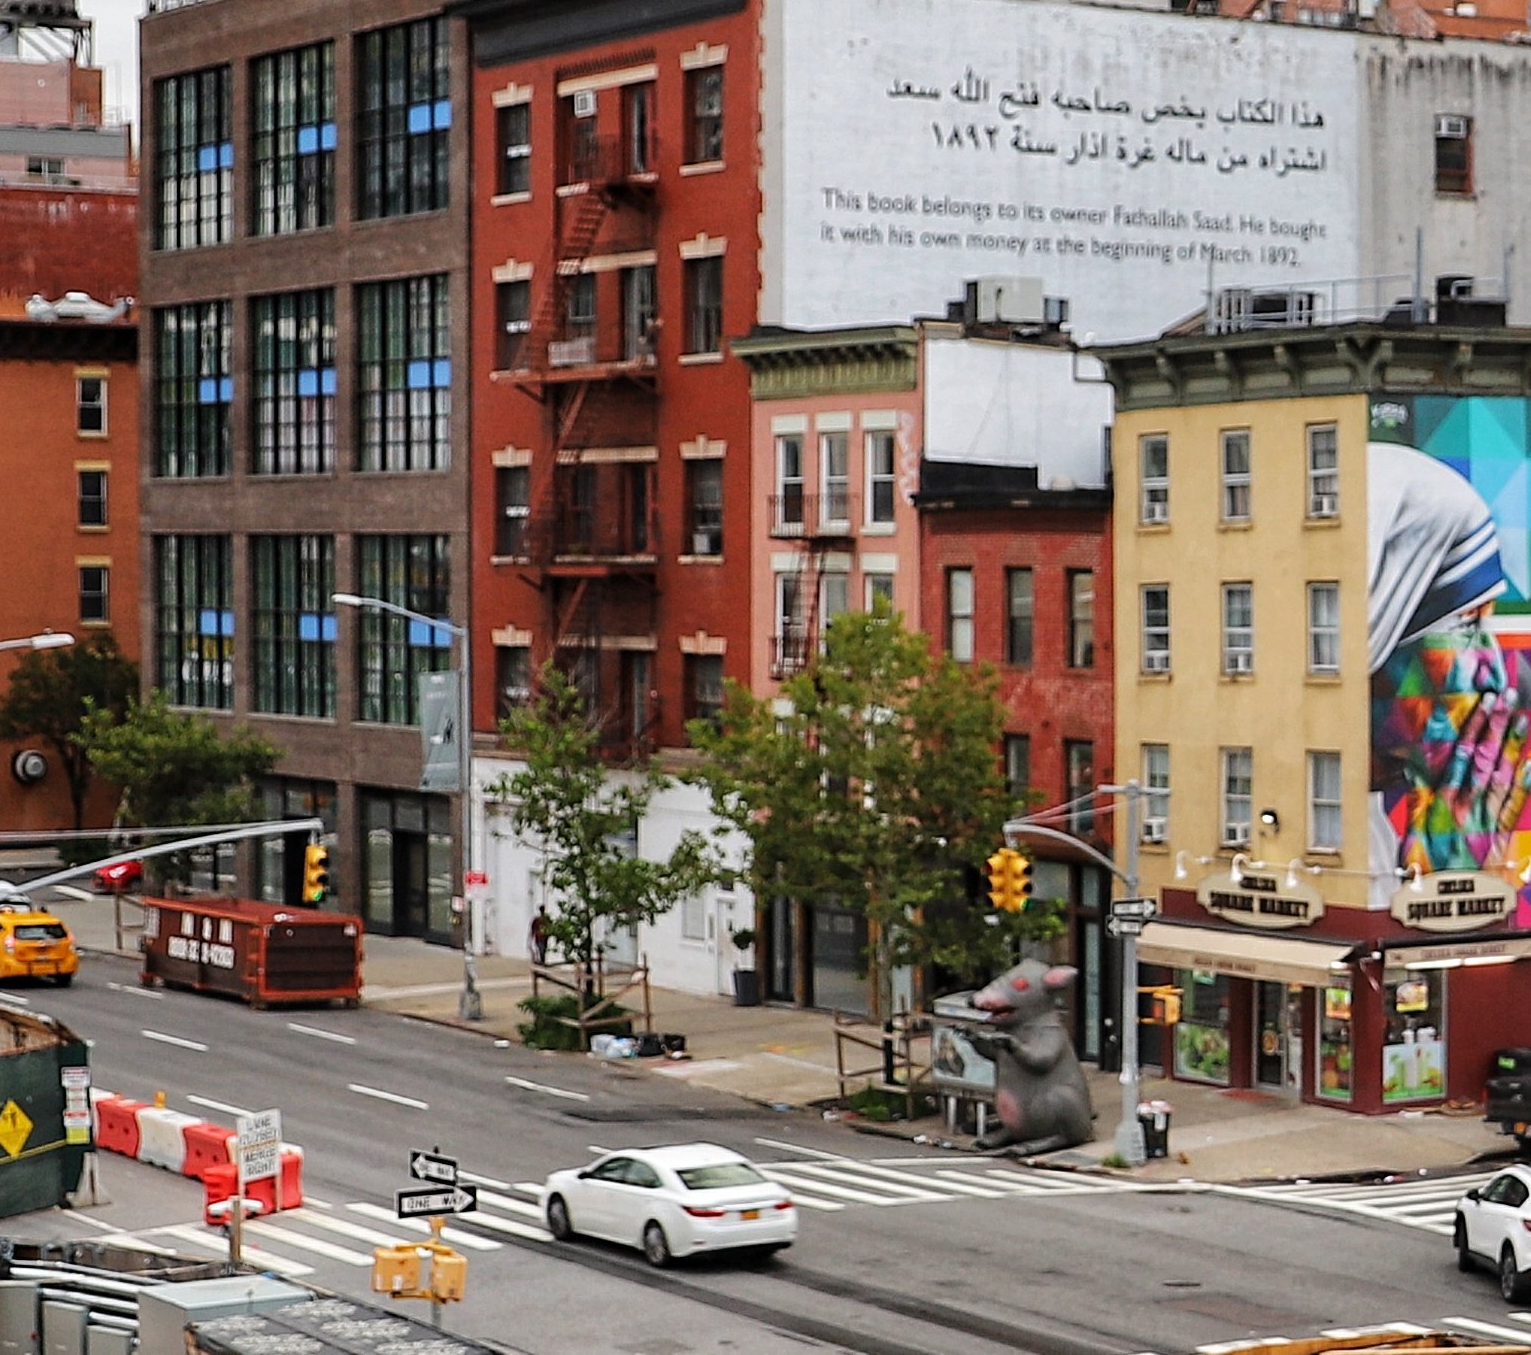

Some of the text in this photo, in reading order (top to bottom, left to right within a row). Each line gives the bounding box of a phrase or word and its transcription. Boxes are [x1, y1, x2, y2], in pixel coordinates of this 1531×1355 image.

[886, 64, 1325, 134] هذا الكتاب يخص صاحبه فتح الله سعد
[931, 121, 999, 151] ١٨٩٢
[1010, 124, 1058, 154] سنة
[1167, 136, 1207, 164] ماله
[1116, 136, 1155, 169] غرة
[1217, 146, 1248, 173] من
[1259, 145, 1326, 177] اشتراه
[822, 187, 1326, 241] This book belongs to its owner Fathallah Saad. He bought
[820, 222, 1301, 267] it with his own money at the beginning of March 1892.
[1437, 878, 1475, 894] CHELSEA
[1210, 891, 1309, 920] SQUARE MARKET
[1407, 895, 1505, 921] SQUARE MARKET
[406, 1195, 431, 1209] ONE
